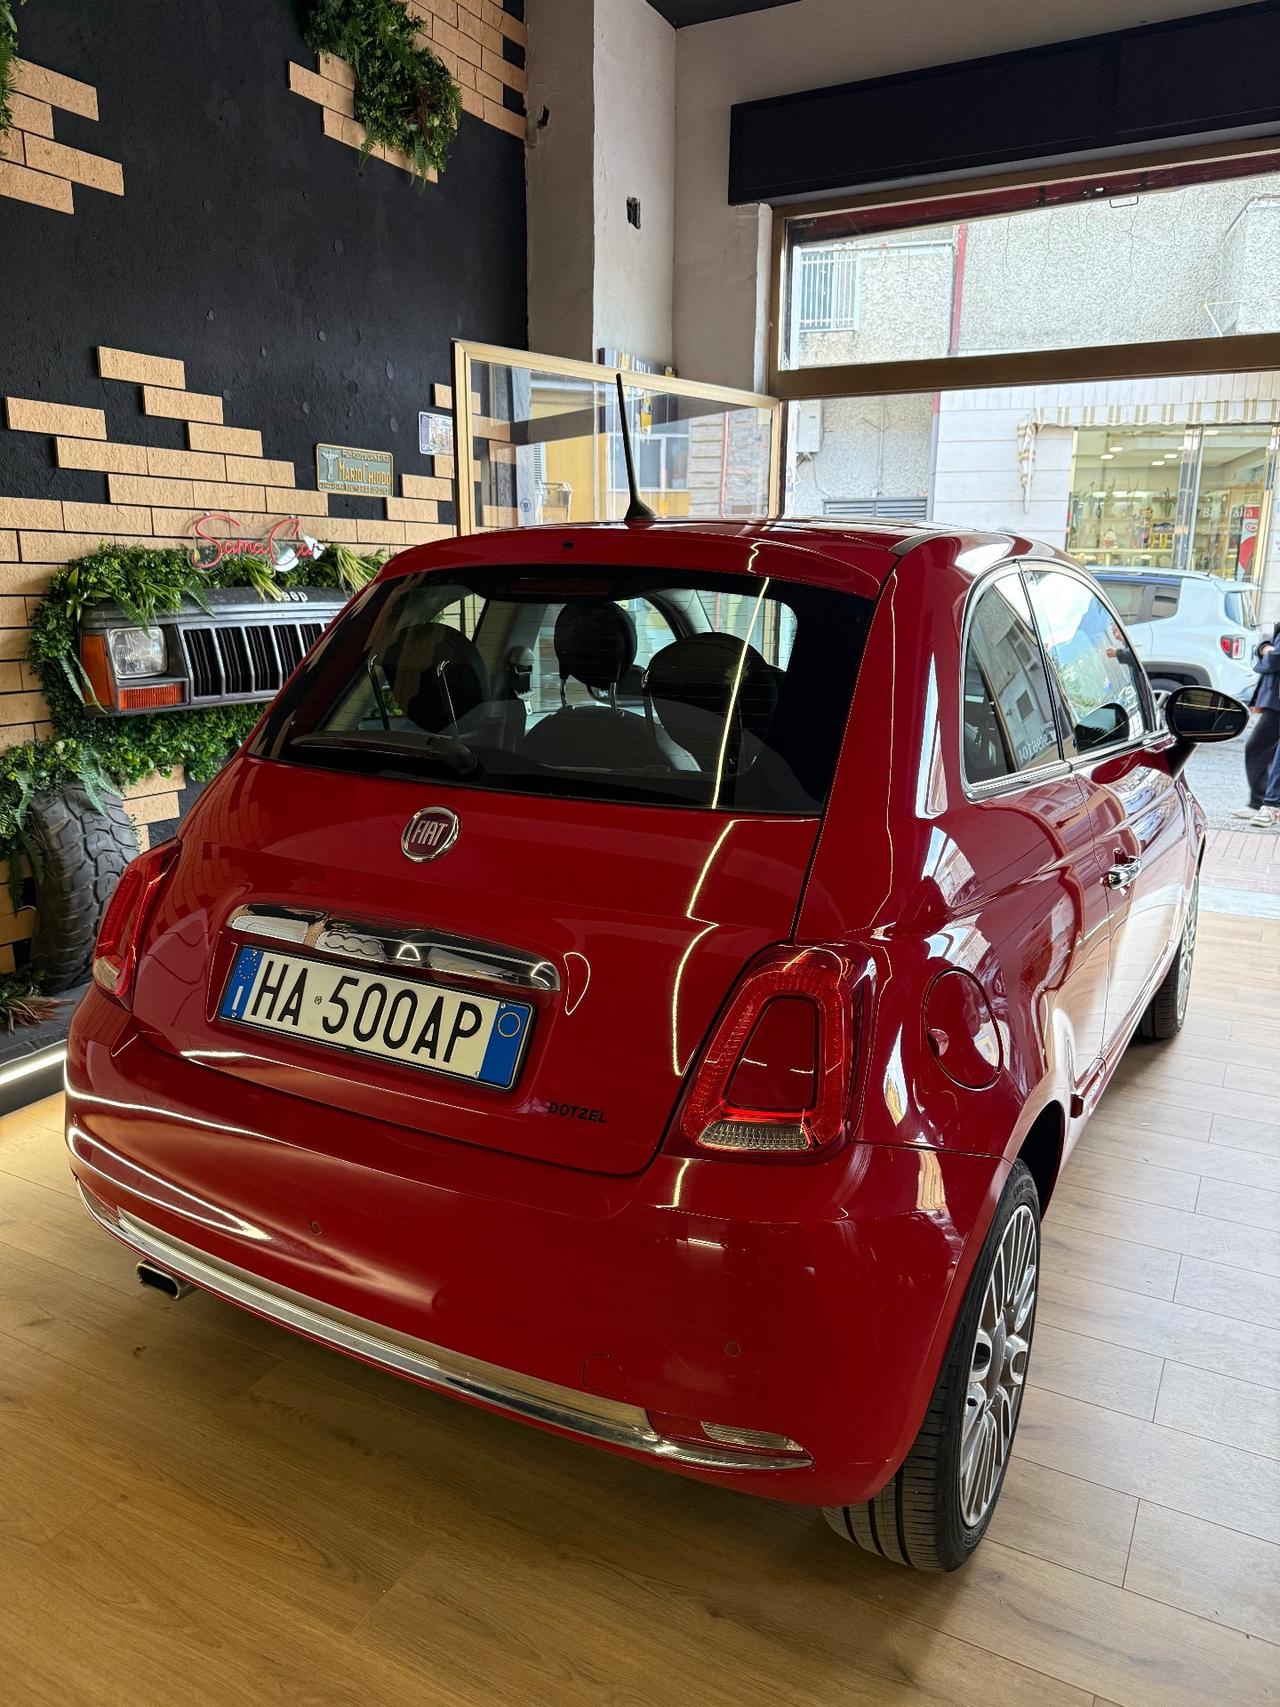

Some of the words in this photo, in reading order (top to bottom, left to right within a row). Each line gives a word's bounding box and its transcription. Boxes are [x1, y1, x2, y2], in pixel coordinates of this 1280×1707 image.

[278, 591, 308, 603] eep
[411, 820, 449, 847] FIAT
[250, 960, 309, 1027] HA
[322, 976, 484, 1064] 500AP
[547, 1102, 607, 1124] DOTZEL
